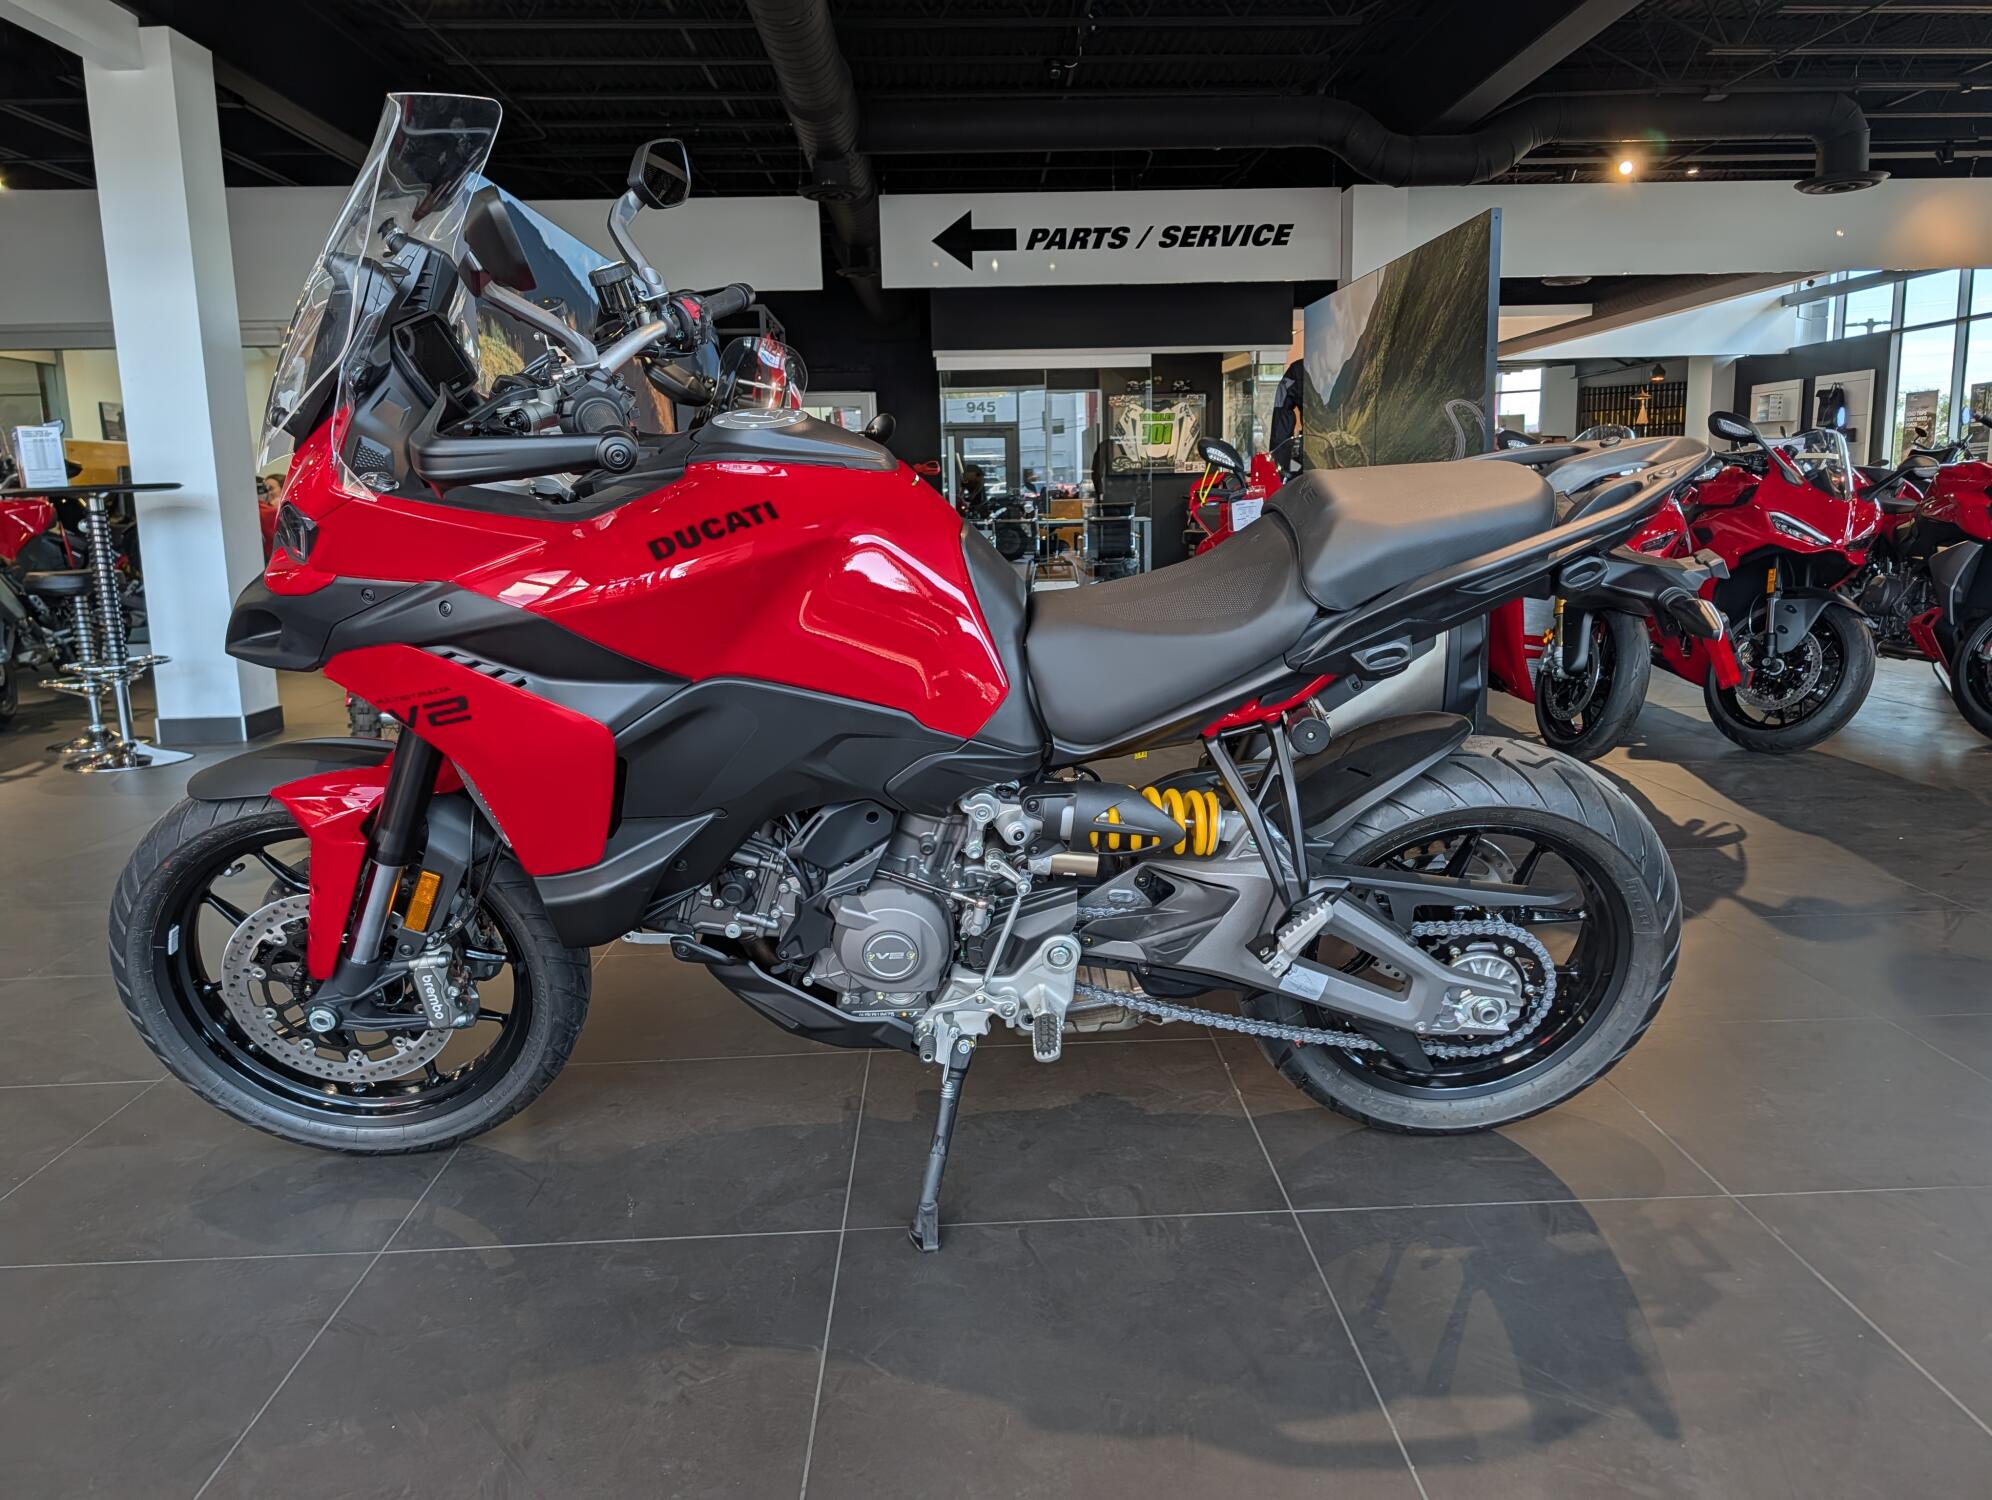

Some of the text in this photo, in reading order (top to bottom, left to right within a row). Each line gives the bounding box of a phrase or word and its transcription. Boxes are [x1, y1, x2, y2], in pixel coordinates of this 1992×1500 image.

[1025, 223, 1295, 250] PARTS / SERVICE
[966, 401, 996, 413] 945
[648, 501, 779, 562] DUCATI
[422, 974, 444, 1020] brembo
